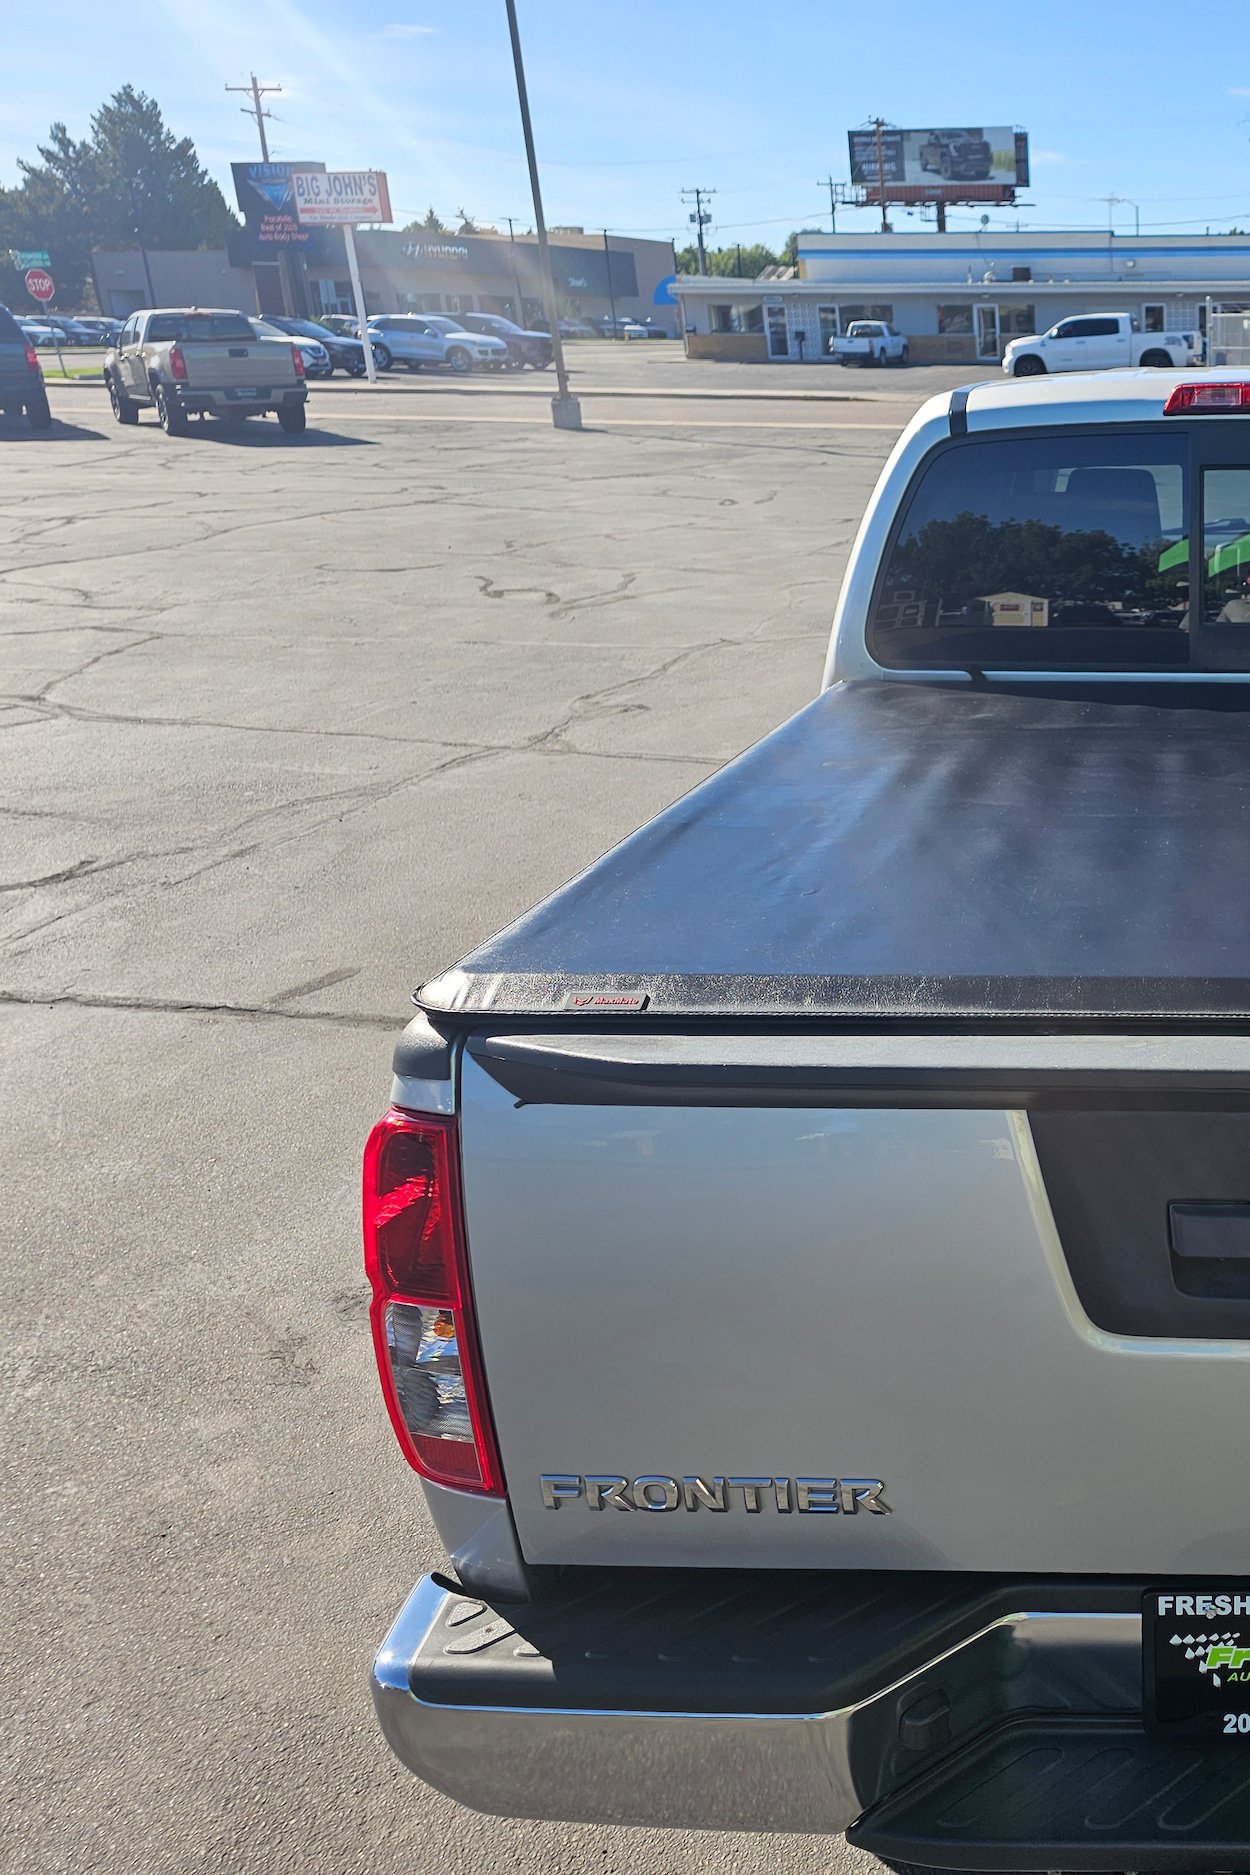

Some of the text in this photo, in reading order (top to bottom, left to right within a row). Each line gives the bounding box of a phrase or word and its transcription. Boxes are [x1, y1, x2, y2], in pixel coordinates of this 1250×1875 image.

[248, 164, 294, 178] VISION
[296, 175, 376, 197] BIG JOHN'S
[304, 197, 329, 205] Mini
[28, 278, 51, 291] STOP
[540, 1473, 893, 1516] FRONTIER
